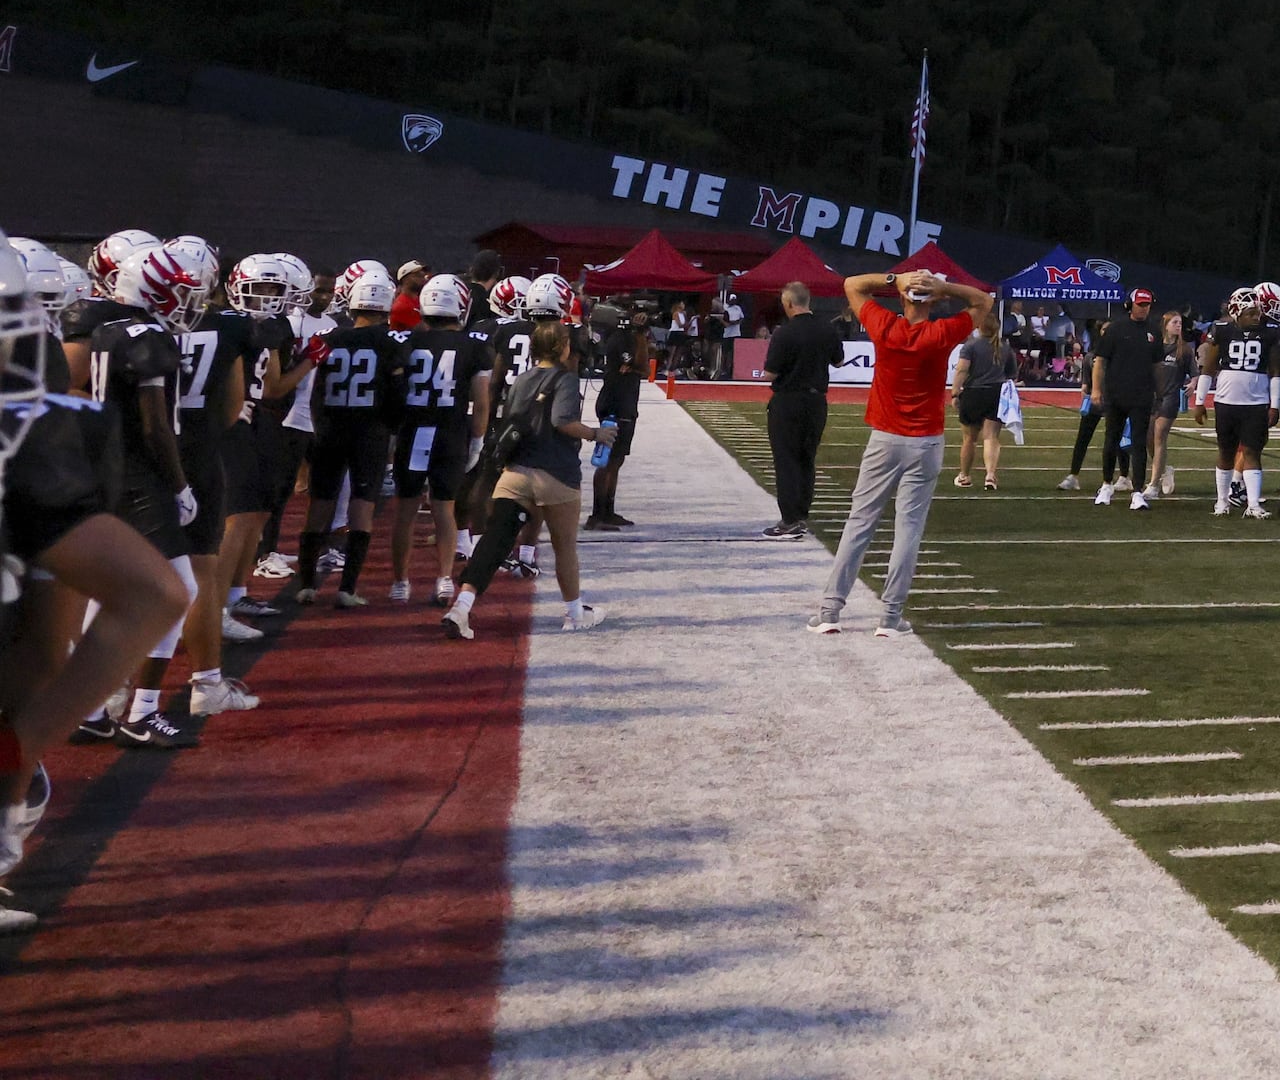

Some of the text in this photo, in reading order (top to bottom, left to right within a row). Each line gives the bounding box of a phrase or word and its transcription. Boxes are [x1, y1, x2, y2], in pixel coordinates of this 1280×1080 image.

[612, 156, 942, 256] THE MPIRE
[1012, 288, 1121, 300] MILTON FOOTBALL
[1044, 267, 1084, 285] M
[324, 348, 378, 407] 22
[406, 349, 457, 407] 24
[505, 334, 533, 385] 3
[1228, 340, 1262, 370] 98
